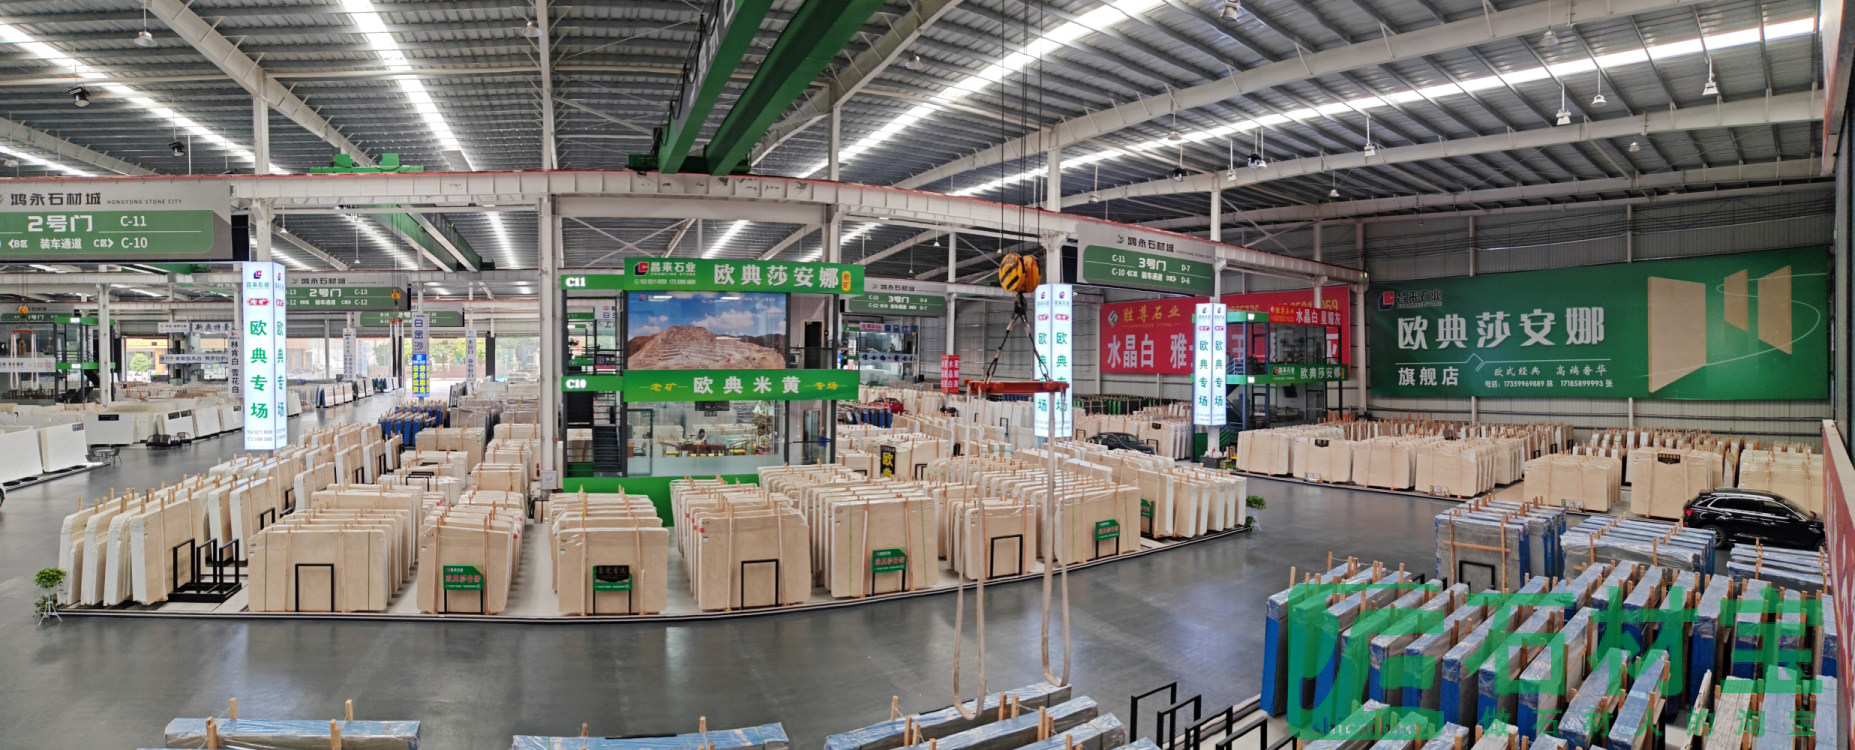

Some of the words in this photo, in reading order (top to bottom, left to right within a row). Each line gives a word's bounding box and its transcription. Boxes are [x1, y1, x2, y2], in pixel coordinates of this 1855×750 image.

[11, 192, 102, 206] 鸿永石材城
[28, 215, 93, 232] 2号门
[121, 215, 147, 227] C-11
[40, 238, 82, 250] 装车通道
[121, 237, 148, 249] C-10
[1112, 255, 1125, 263] C-11
[1139, 258, 1166, 271] 3号门
[566, 277, 586, 287] C11
[651, 262, 696, 273] 昌来石业
[714, 264, 839, 288] 欧典莎安娜
[1112, 268, 1125, 276] C-10
[1181, 276, 1191, 284] D-6
[310, 289, 341, 297] 2号门
[1296, 309, 1318, 323] 水晶白
[1398, 307, 1605, 350] 欧典莎安娜
[1107, 334, 1154, 369] 水晶白
[1170, 333, 1193, 368] 雅
[250, 320, 268, 419] 欧典专场
[1038, 332, 1048, 412] 欧典场
[1199, 341, 1209, 406] 欧典专场
[1215, 341, 1223, 406] 欧典专场
[1301, 367, 1340, 379] 欧典莎安娜
[1399, 367, 1459, 386] 旗舰店
[1495, 366, 1541, 376] 欧式经典
[566, 379, 586, 389] C10
[693, 376, 800, 394] 欧典米黄
